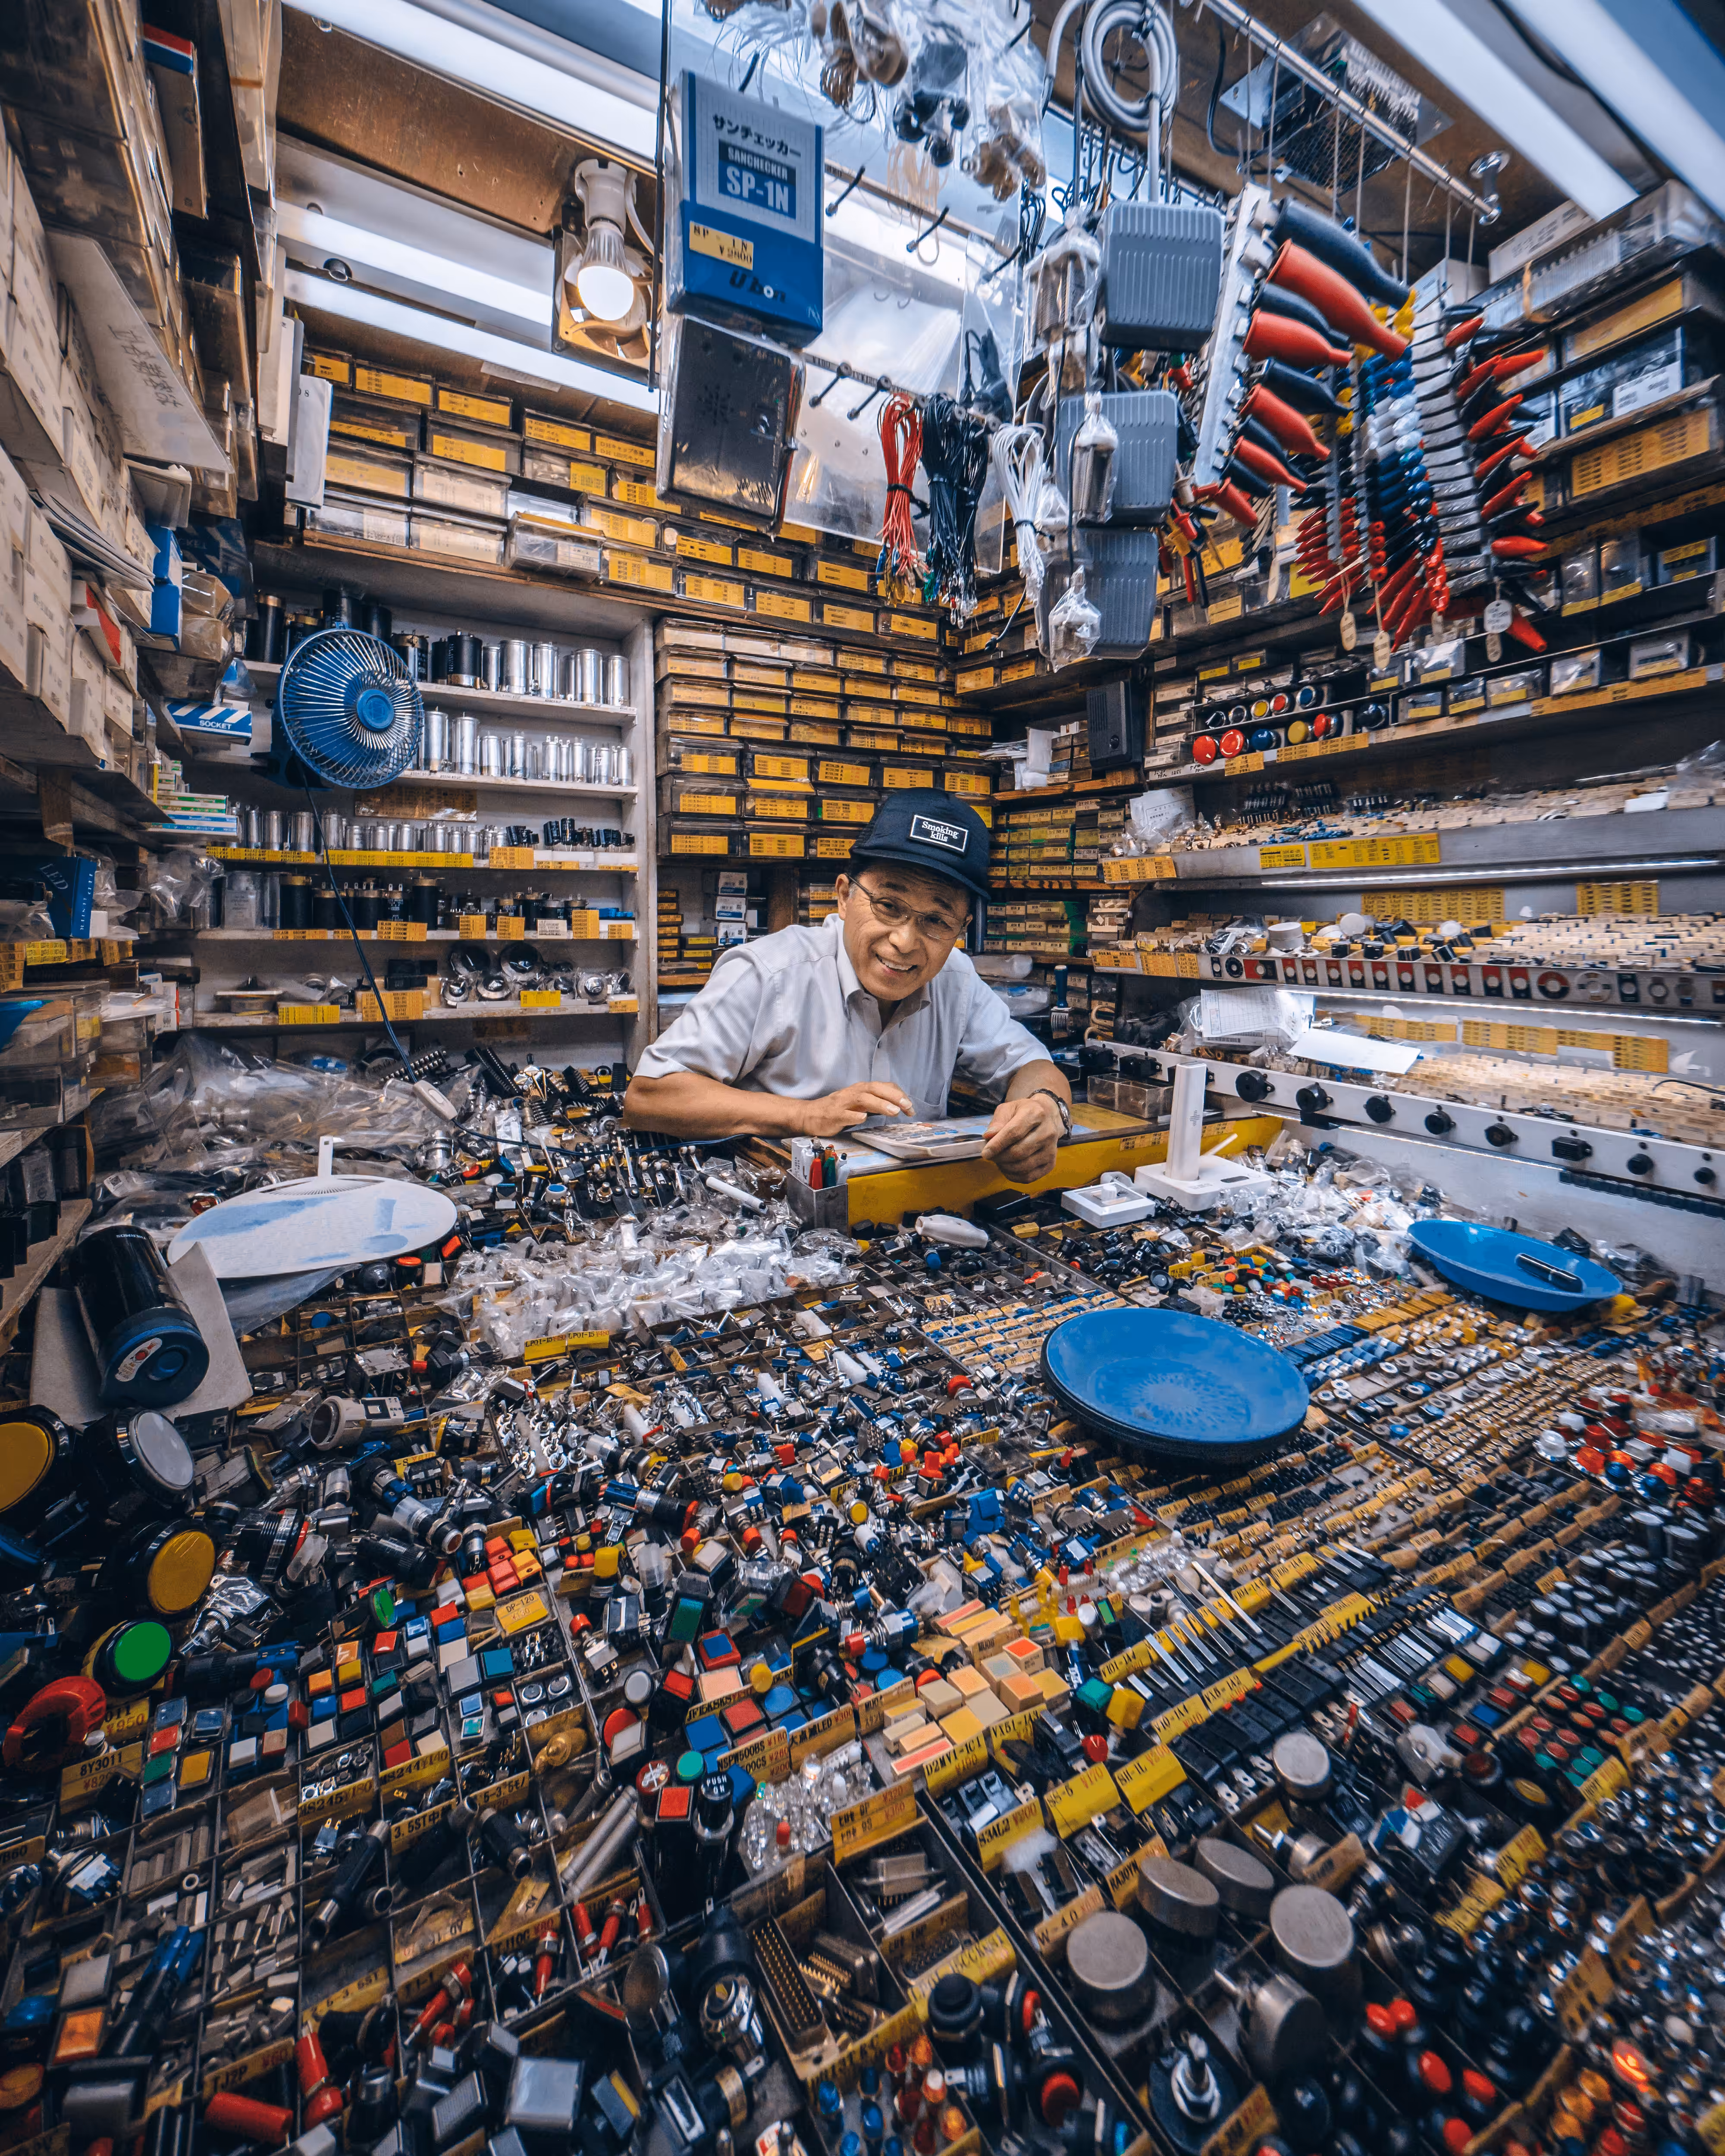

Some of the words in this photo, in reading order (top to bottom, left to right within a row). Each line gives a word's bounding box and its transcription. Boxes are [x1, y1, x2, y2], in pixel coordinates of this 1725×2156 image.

[713, 114, 801, 158] サンチェッカー
[728, 147, 787, 181] SANCHECKER
[726, 166, 789, 213] SP-1N
[199, 720, 232, 730] SOCKET
[922, 821, 959, 839] Smoking
[929, 831, 948, 842] kills
[40, 864, 69, 889] LED
[505, 1595, 535, 1614] DP-120
[80, 1752, 123, 1777] 8Y3011
[706, 1774, 728, 1787] PUSH
[713, 1783, 724, 1795] ON
